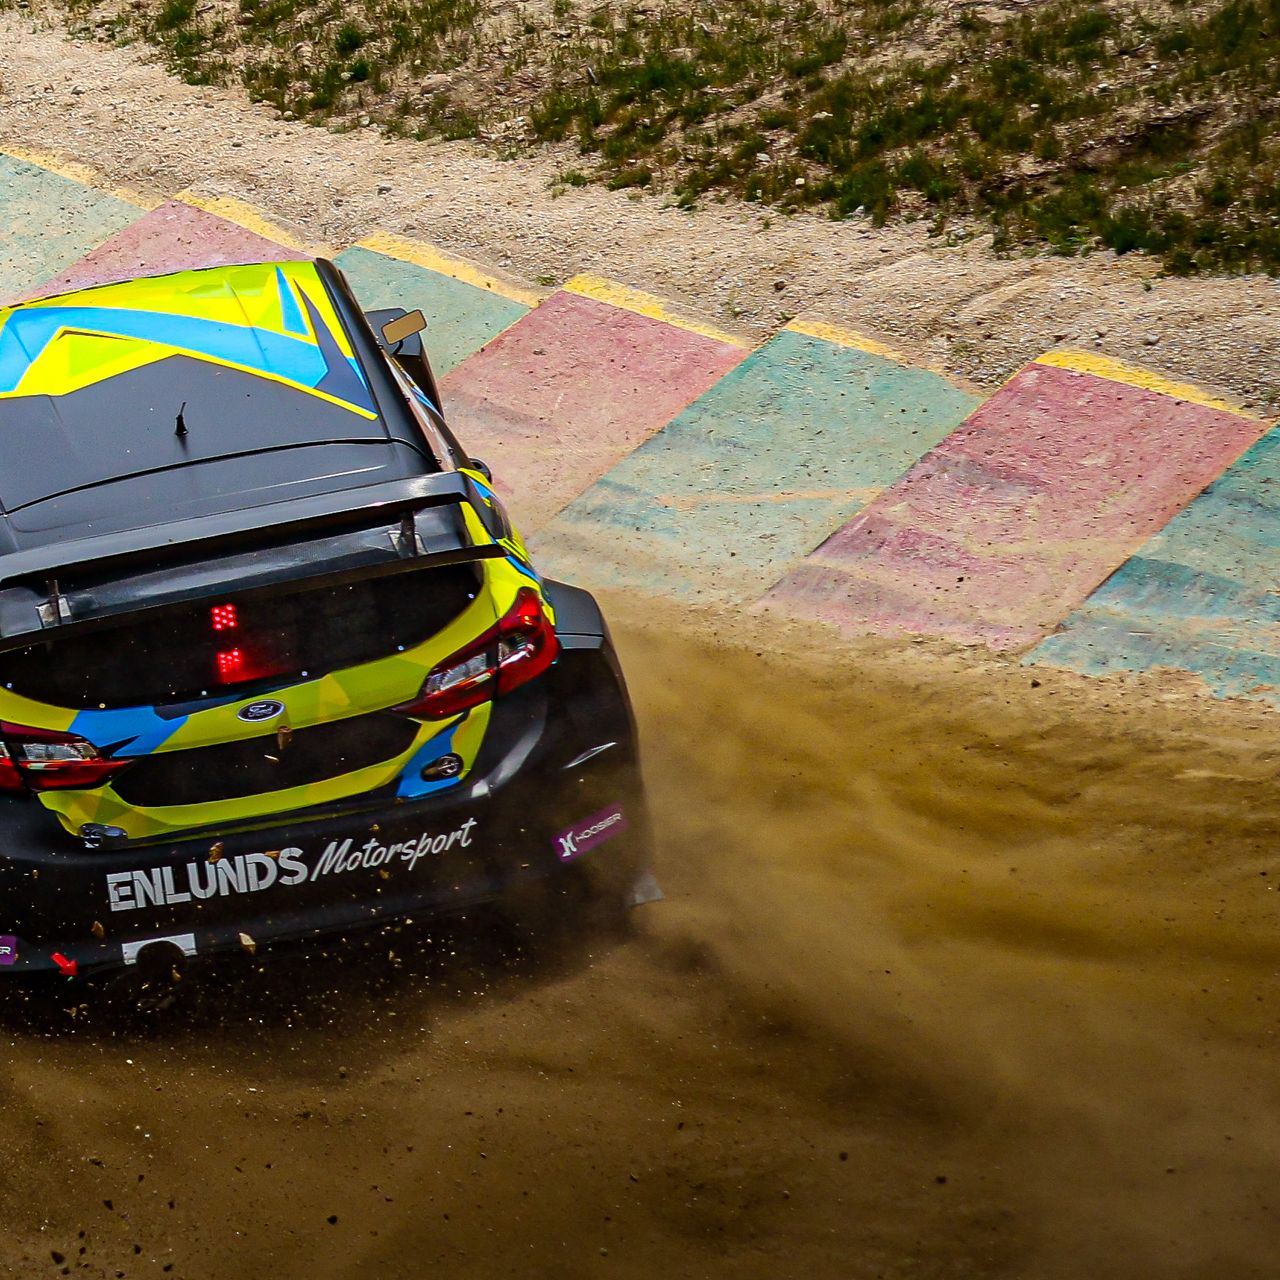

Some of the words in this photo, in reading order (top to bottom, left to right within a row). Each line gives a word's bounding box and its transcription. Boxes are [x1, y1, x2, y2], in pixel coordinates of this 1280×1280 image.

[574, 812, 622, 843] HOOSIER
[106, 847, 308, 912] ENLUNDS
[310, 817, 478, 882] Motorsport
